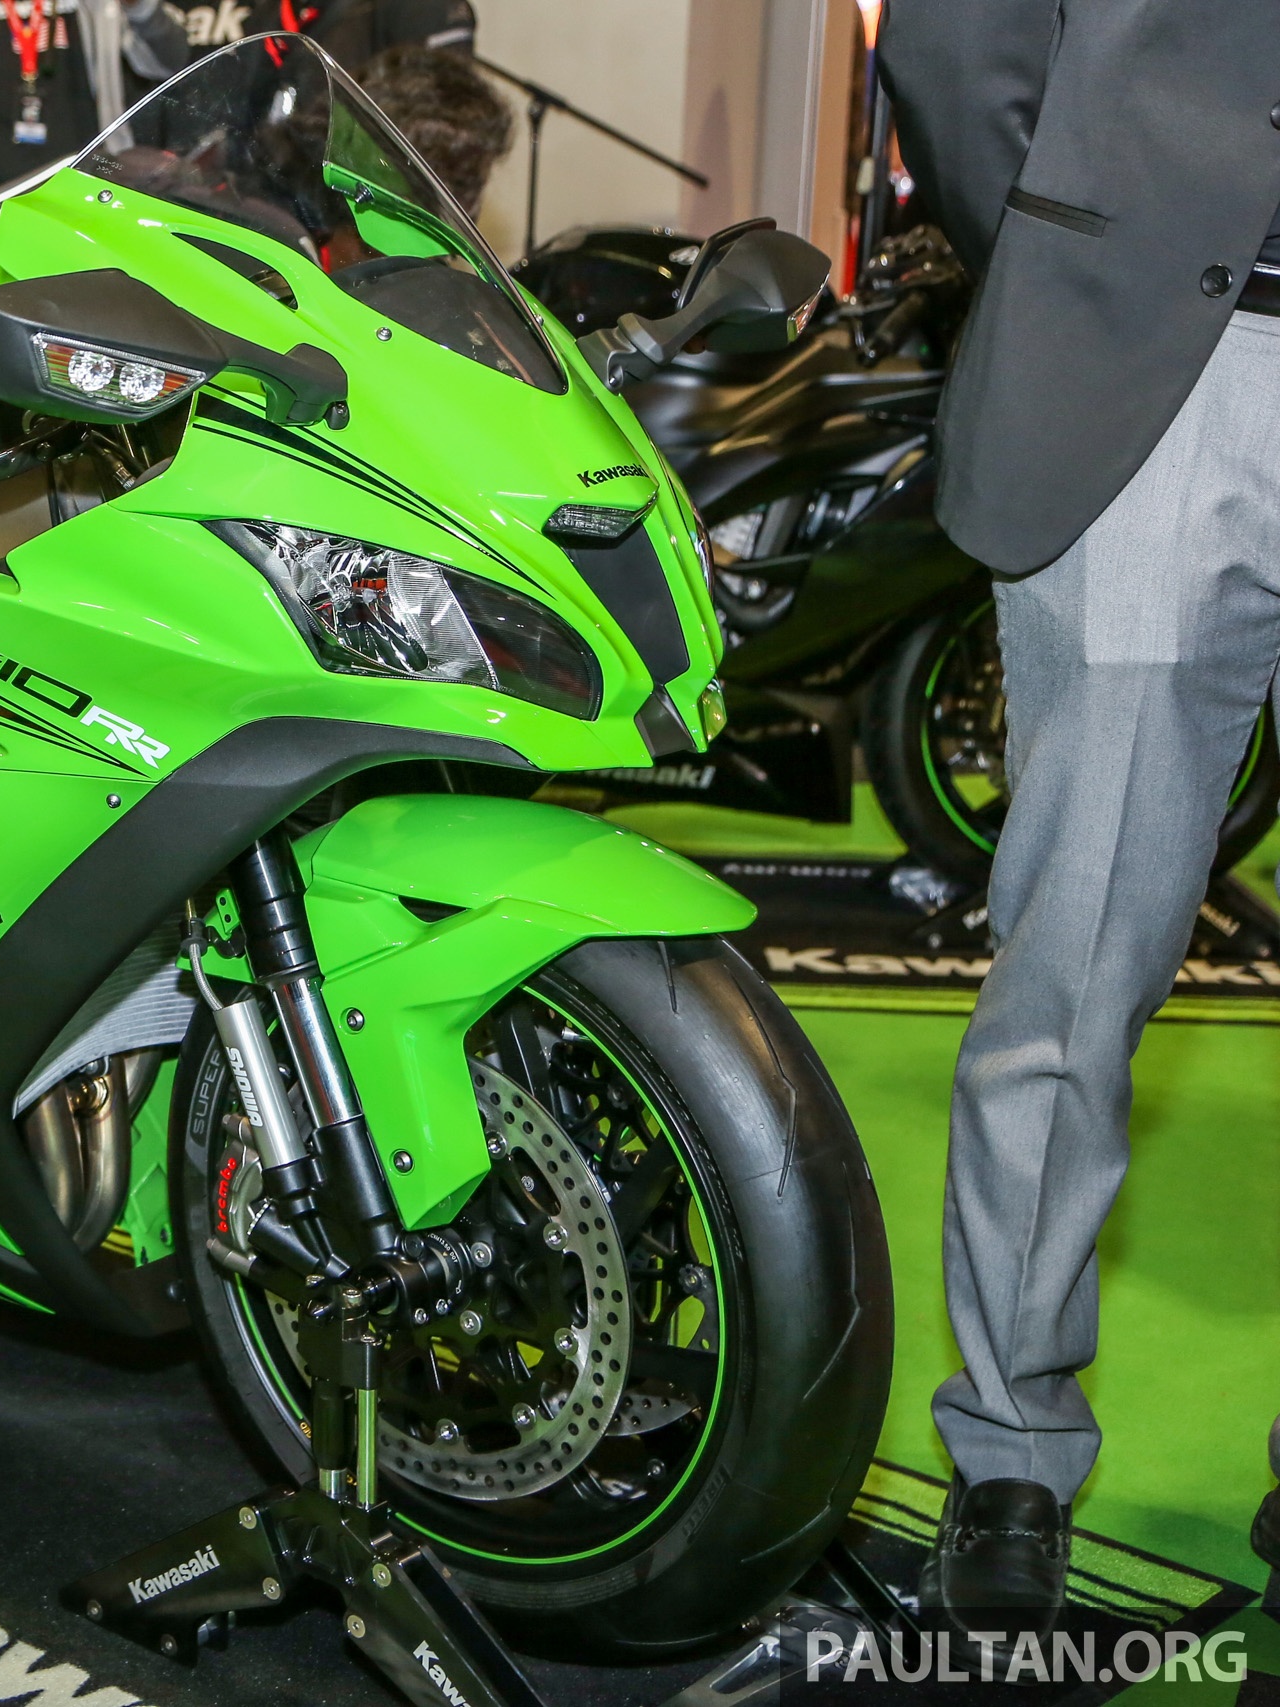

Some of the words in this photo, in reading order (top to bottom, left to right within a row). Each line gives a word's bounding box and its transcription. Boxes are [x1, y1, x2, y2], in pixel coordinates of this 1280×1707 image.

[226, 1045, 264, 1128] SHOWA
[217, 1156, 238, 1233] brembo
[127, 1544, 221, 1604] Kawasaki
